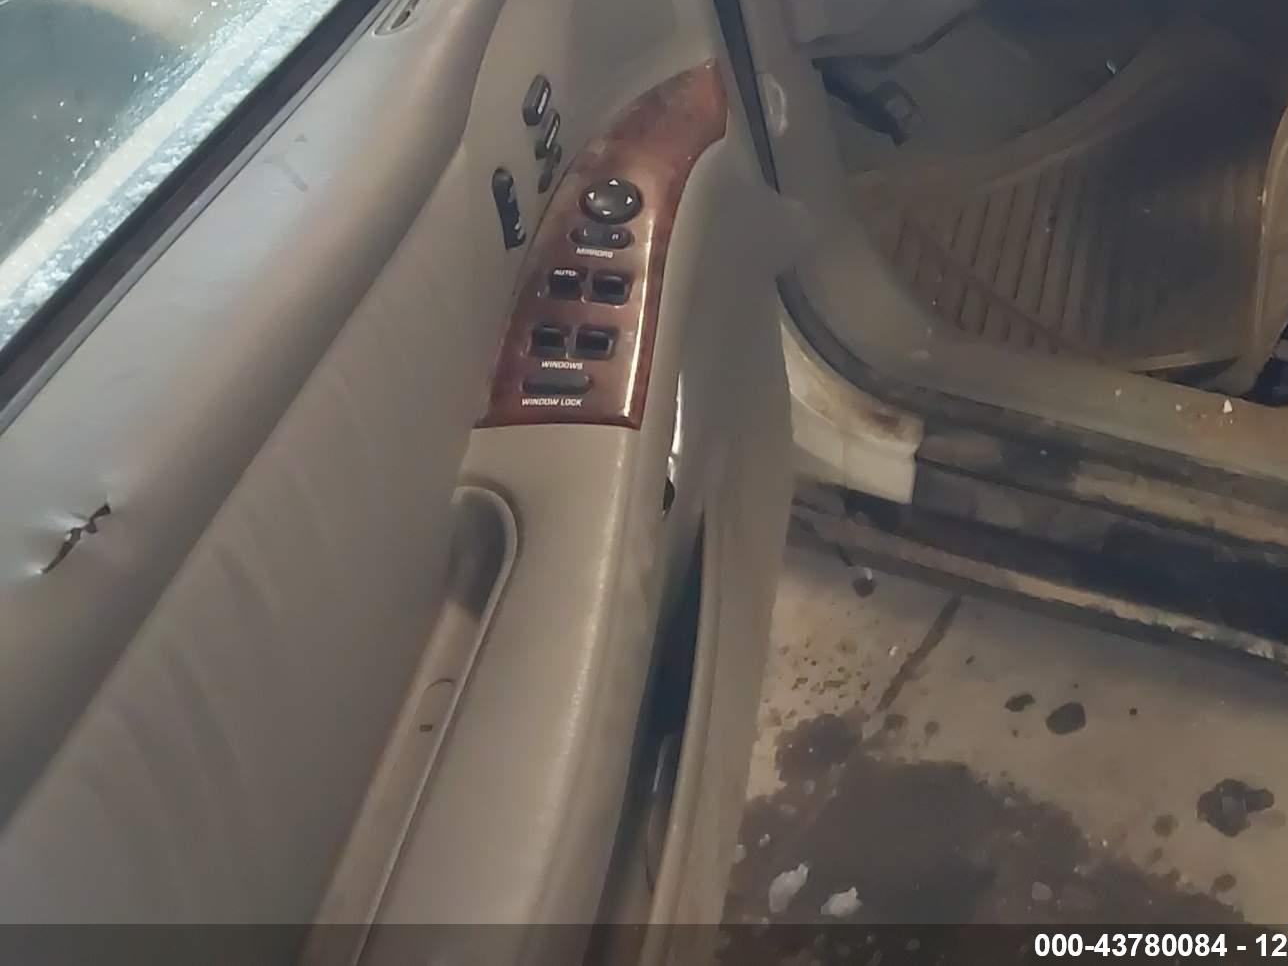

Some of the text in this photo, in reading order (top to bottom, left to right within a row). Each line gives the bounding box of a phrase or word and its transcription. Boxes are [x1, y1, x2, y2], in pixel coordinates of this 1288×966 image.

[575, 247, 614, 259] MIRRORS
[553, 268, 576, 277] AUTO
[541, 360, 583, 370] WINDOWS
[521, 397, 582, 407] WINDOW LOCK
